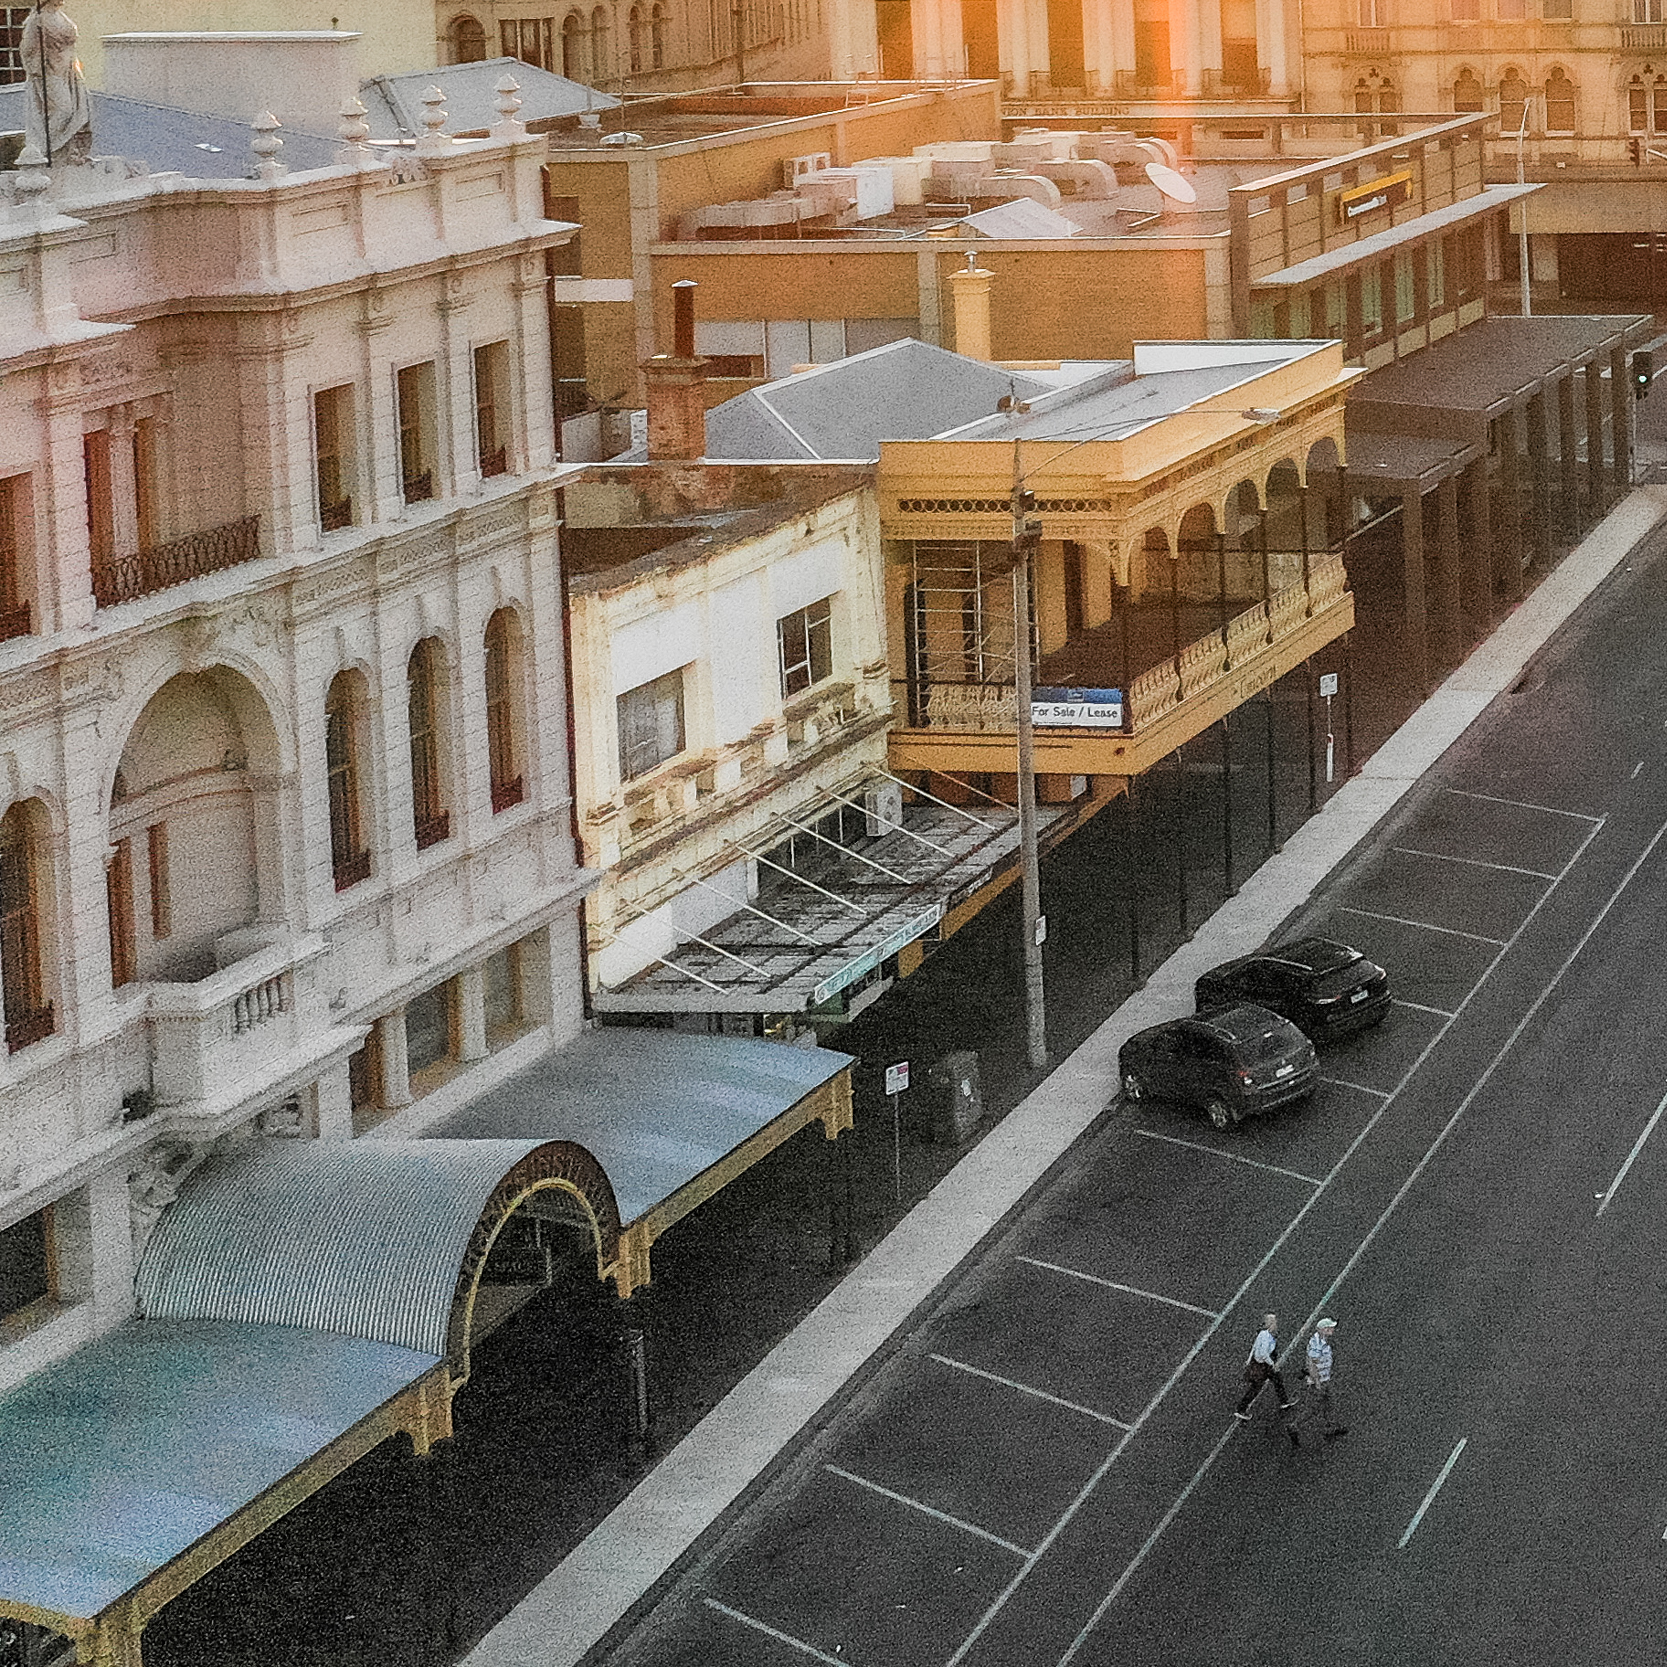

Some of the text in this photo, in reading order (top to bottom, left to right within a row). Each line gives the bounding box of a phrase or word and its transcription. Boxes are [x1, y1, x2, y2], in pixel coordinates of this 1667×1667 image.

[1032, 706, 1048, 717] For
[1053, 707, 1075, 718] Sale
[1088, 707, 1118, 718] Lease
